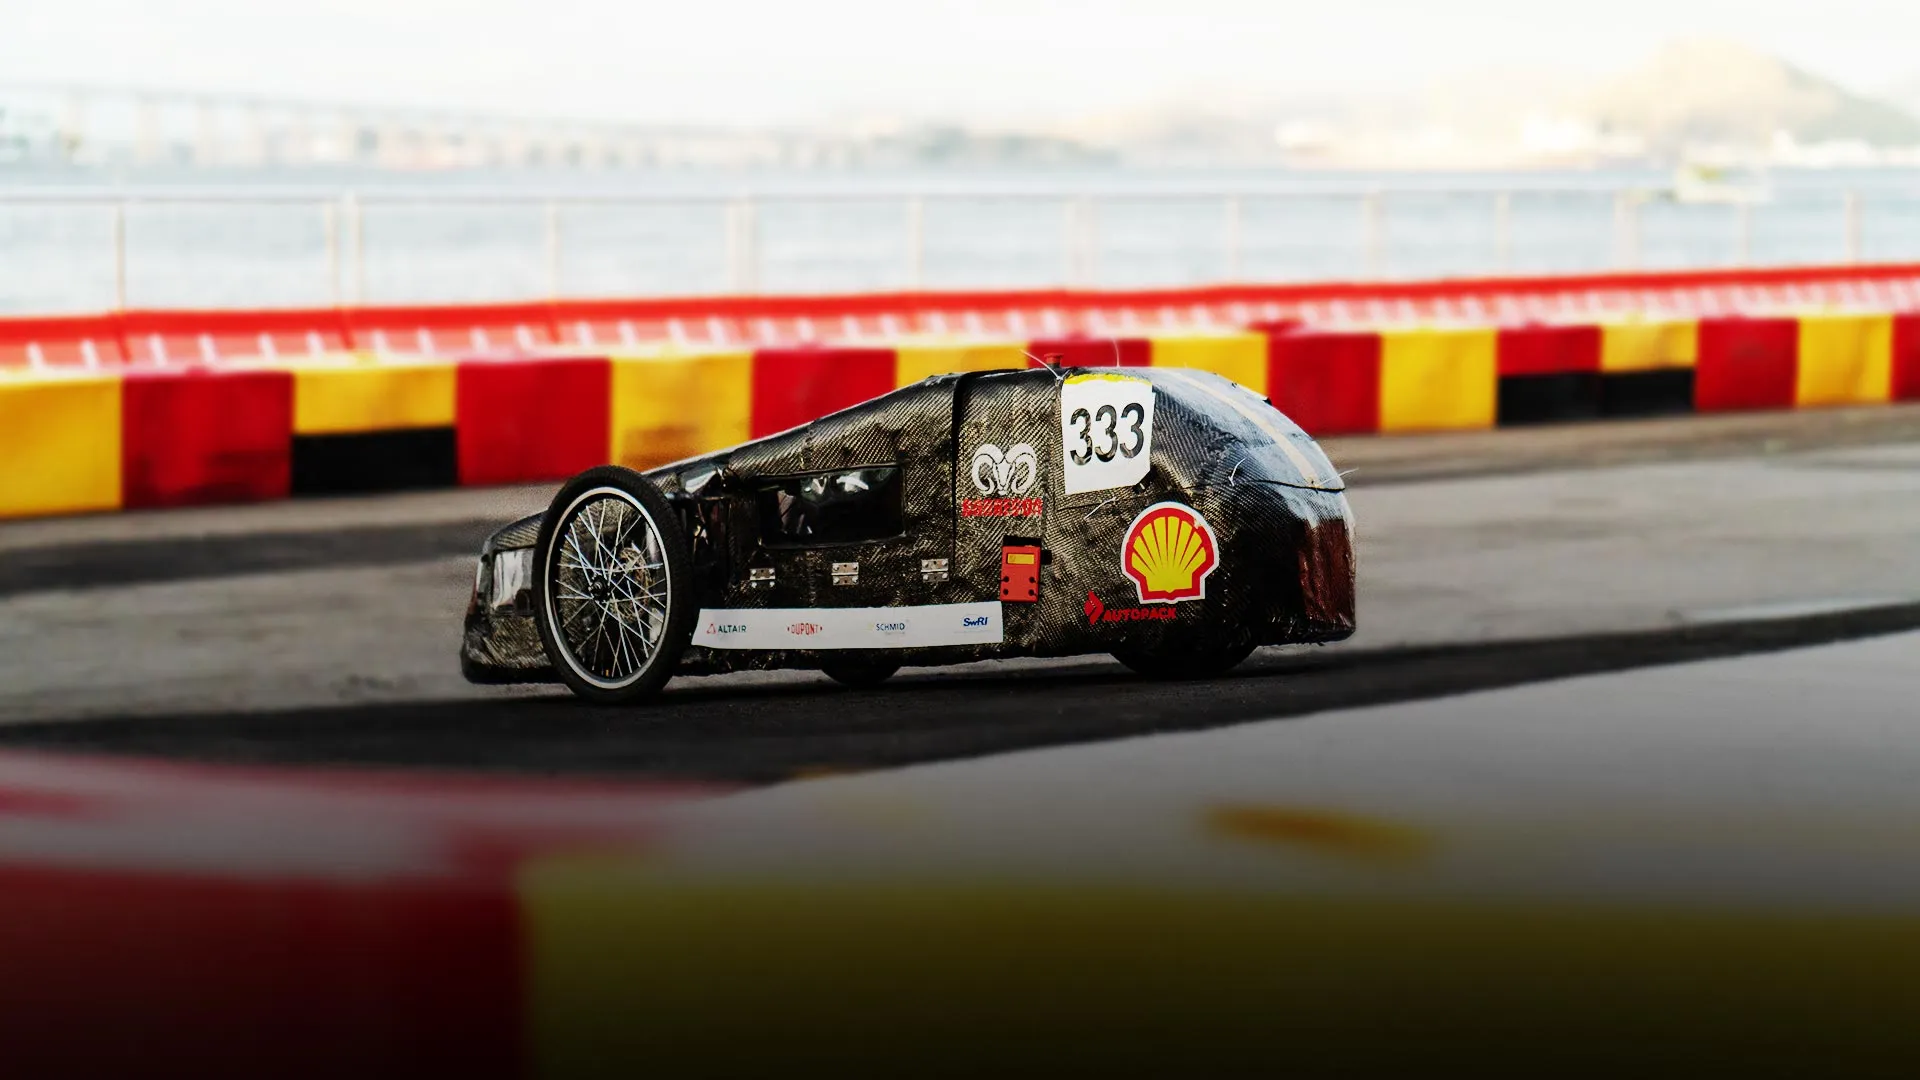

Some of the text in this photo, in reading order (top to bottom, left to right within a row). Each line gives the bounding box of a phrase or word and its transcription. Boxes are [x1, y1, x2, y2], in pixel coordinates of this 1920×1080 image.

[1069, 402, 1145, 466] 333
[1102, 607, 1177, 622] AUTOPACK
[876, 622, 905, 631] SCHMID
[963, 617, 988, 627] SwRI
[718, 625, 747, 633] ALTAIR
[791, 623, 819, 635] DUPONT
